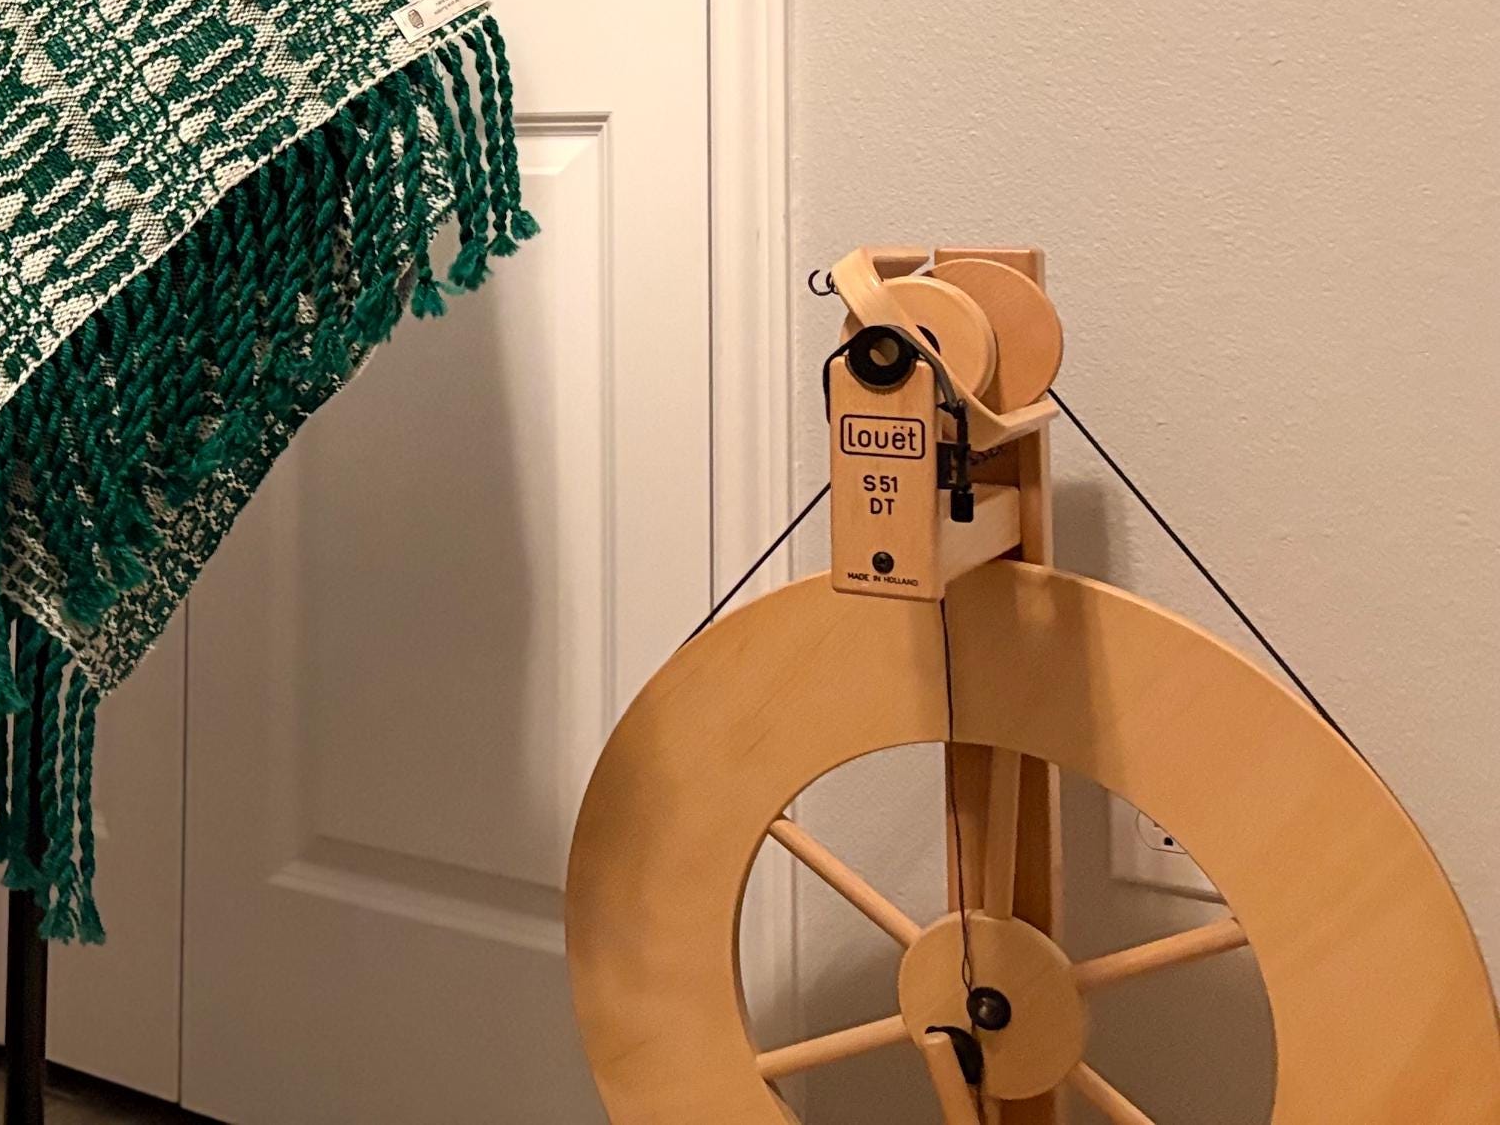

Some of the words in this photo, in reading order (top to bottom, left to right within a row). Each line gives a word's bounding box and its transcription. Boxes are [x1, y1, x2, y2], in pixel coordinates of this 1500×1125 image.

[870, 498, 895, 515] DT
[847, 571, 870, 582] MADE
[873, 574, 881, 582] IN
[884, 576, 919, 587] HOLLAND
